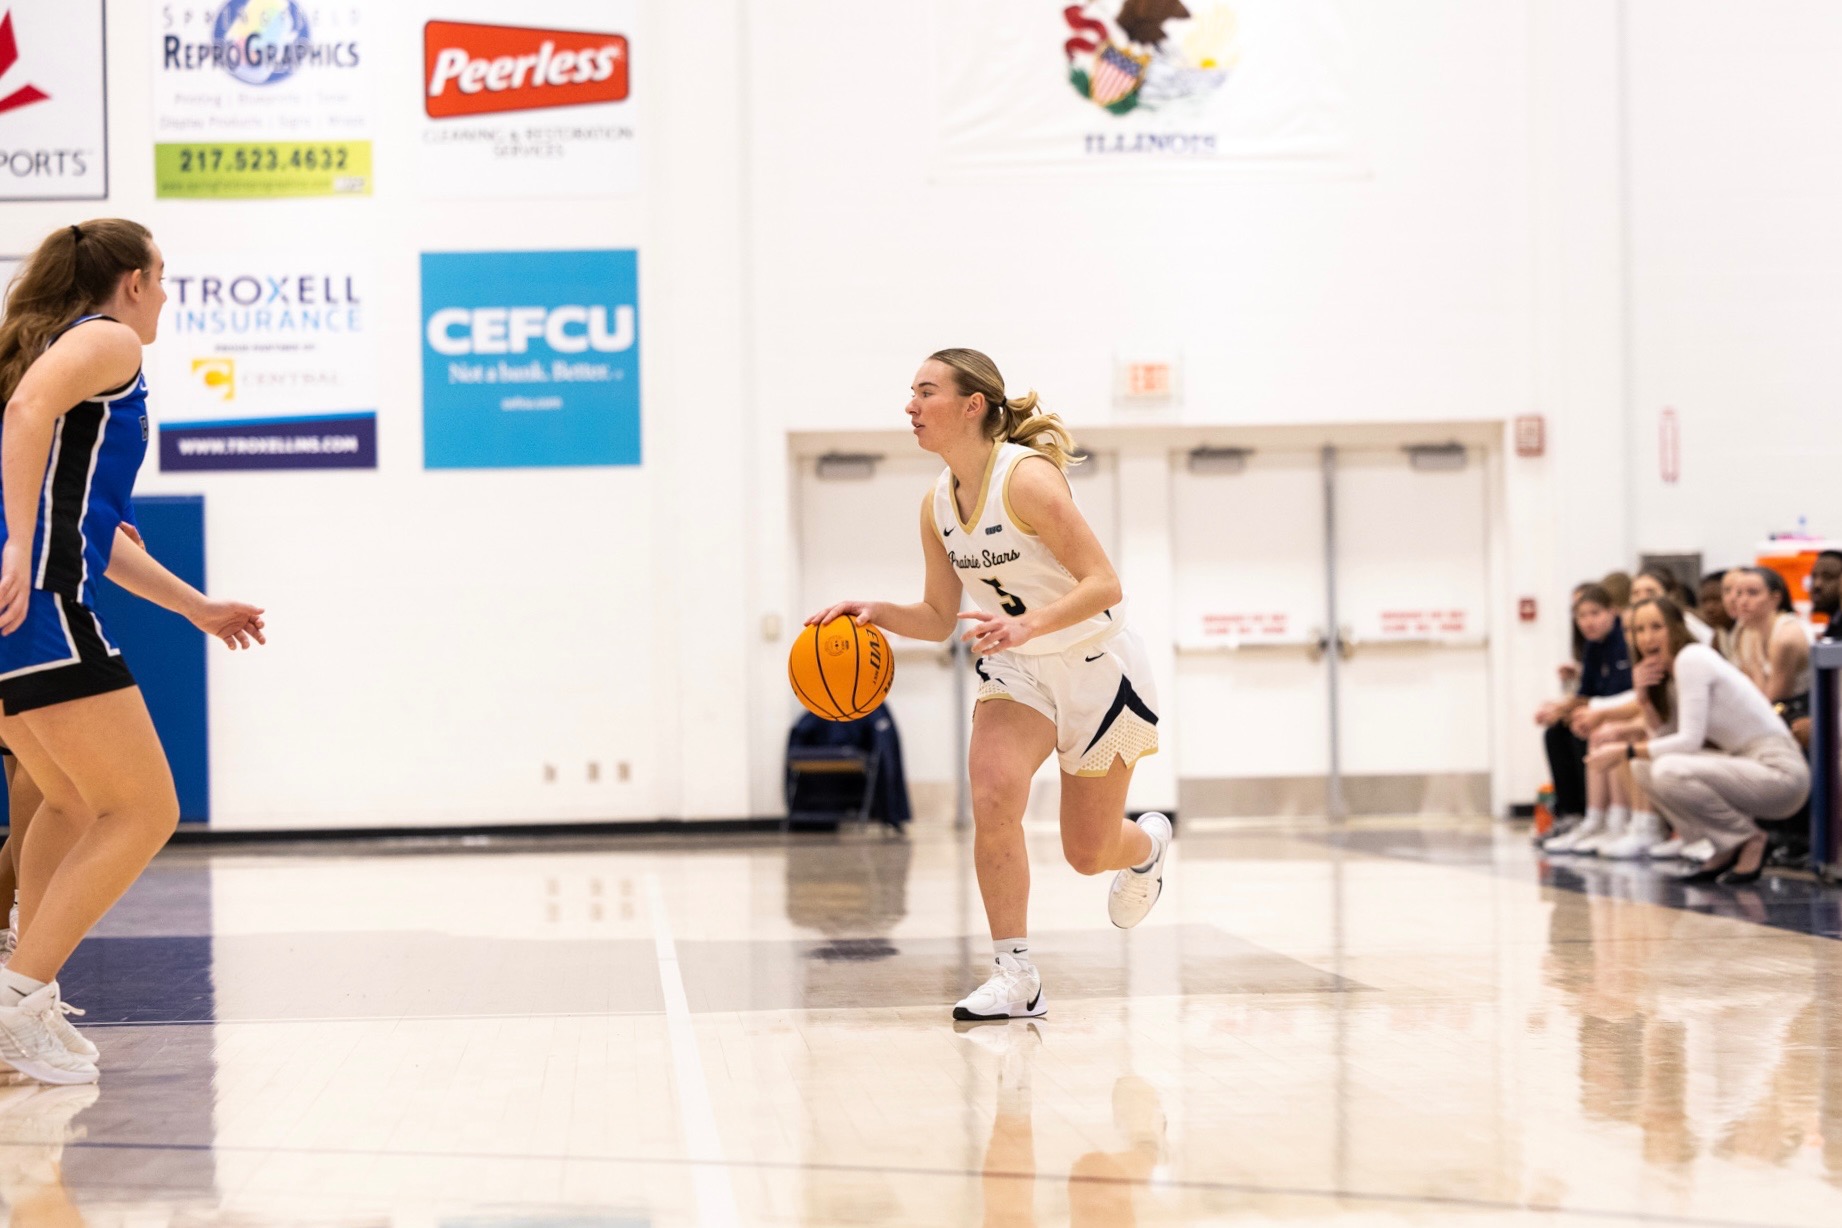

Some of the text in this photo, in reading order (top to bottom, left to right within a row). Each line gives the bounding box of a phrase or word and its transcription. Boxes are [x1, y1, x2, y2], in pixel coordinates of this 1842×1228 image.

[428, 39, 622, 97] Peerless
[1084, 133, 1217, 154] ILLINOIS
[178, 148, 349, 174] 217.523.4632
[170, 275, 361, 306] TROXELL
[173, 308, 364, 334] INSURANCE
[426, 303, 636, 357] CEFCU
[448, 361, 484, 385] Not
[486, 366, 497, 384] a
[499, 360, 549, 384] bank.
[981, 549, 1021, 568] Stars
